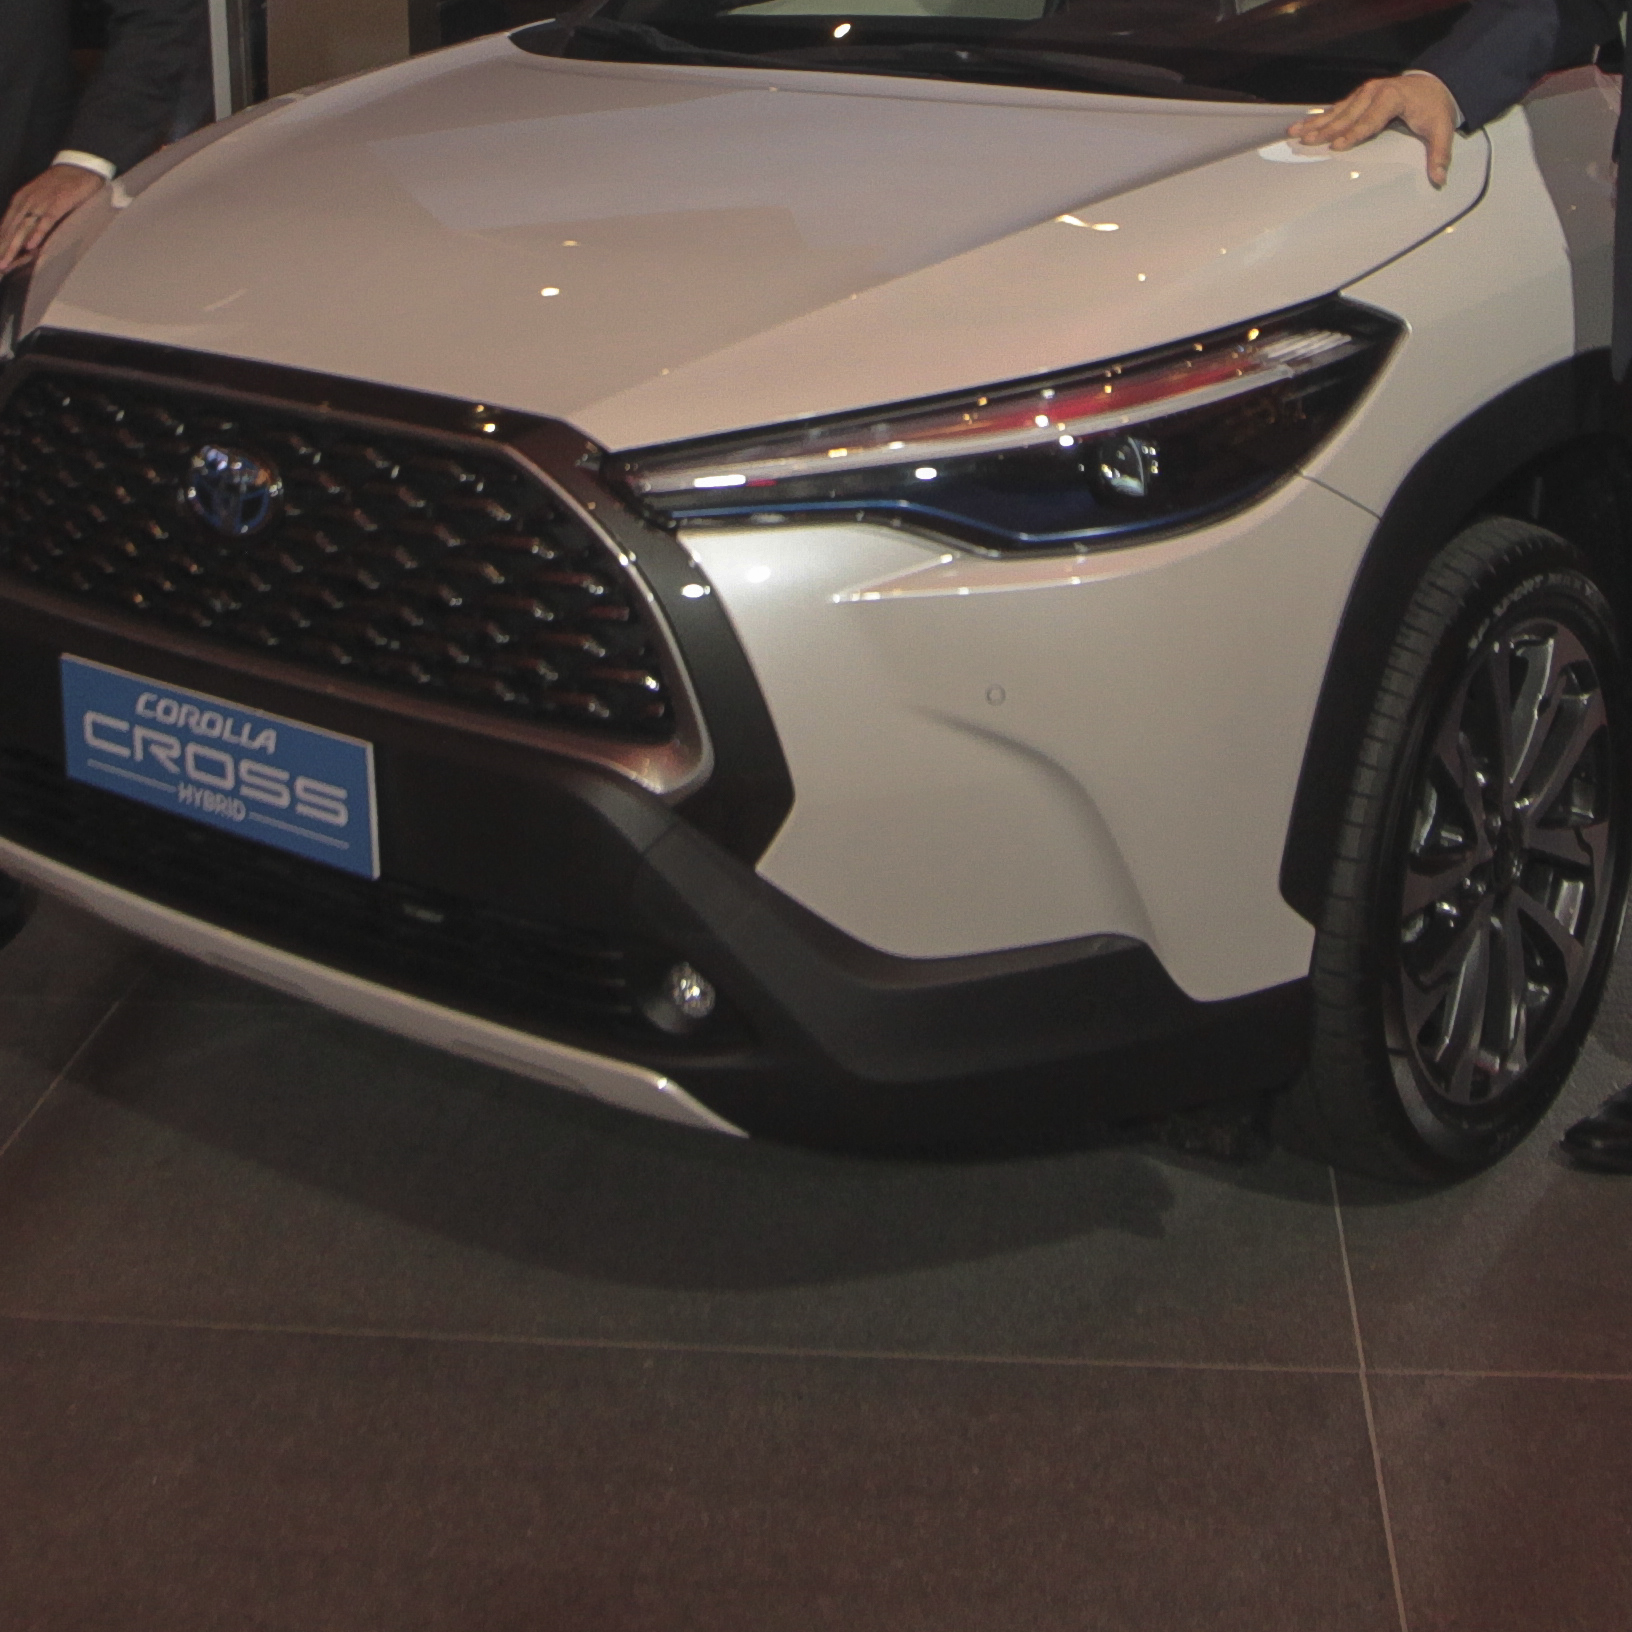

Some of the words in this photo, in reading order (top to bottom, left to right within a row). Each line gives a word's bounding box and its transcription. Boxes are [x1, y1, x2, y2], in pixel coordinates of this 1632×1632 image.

[135, 691, 277, 755] COROLLA
[83, 709, 349, 828] CROSS
[177, 782, 247, 822] HYBRID
